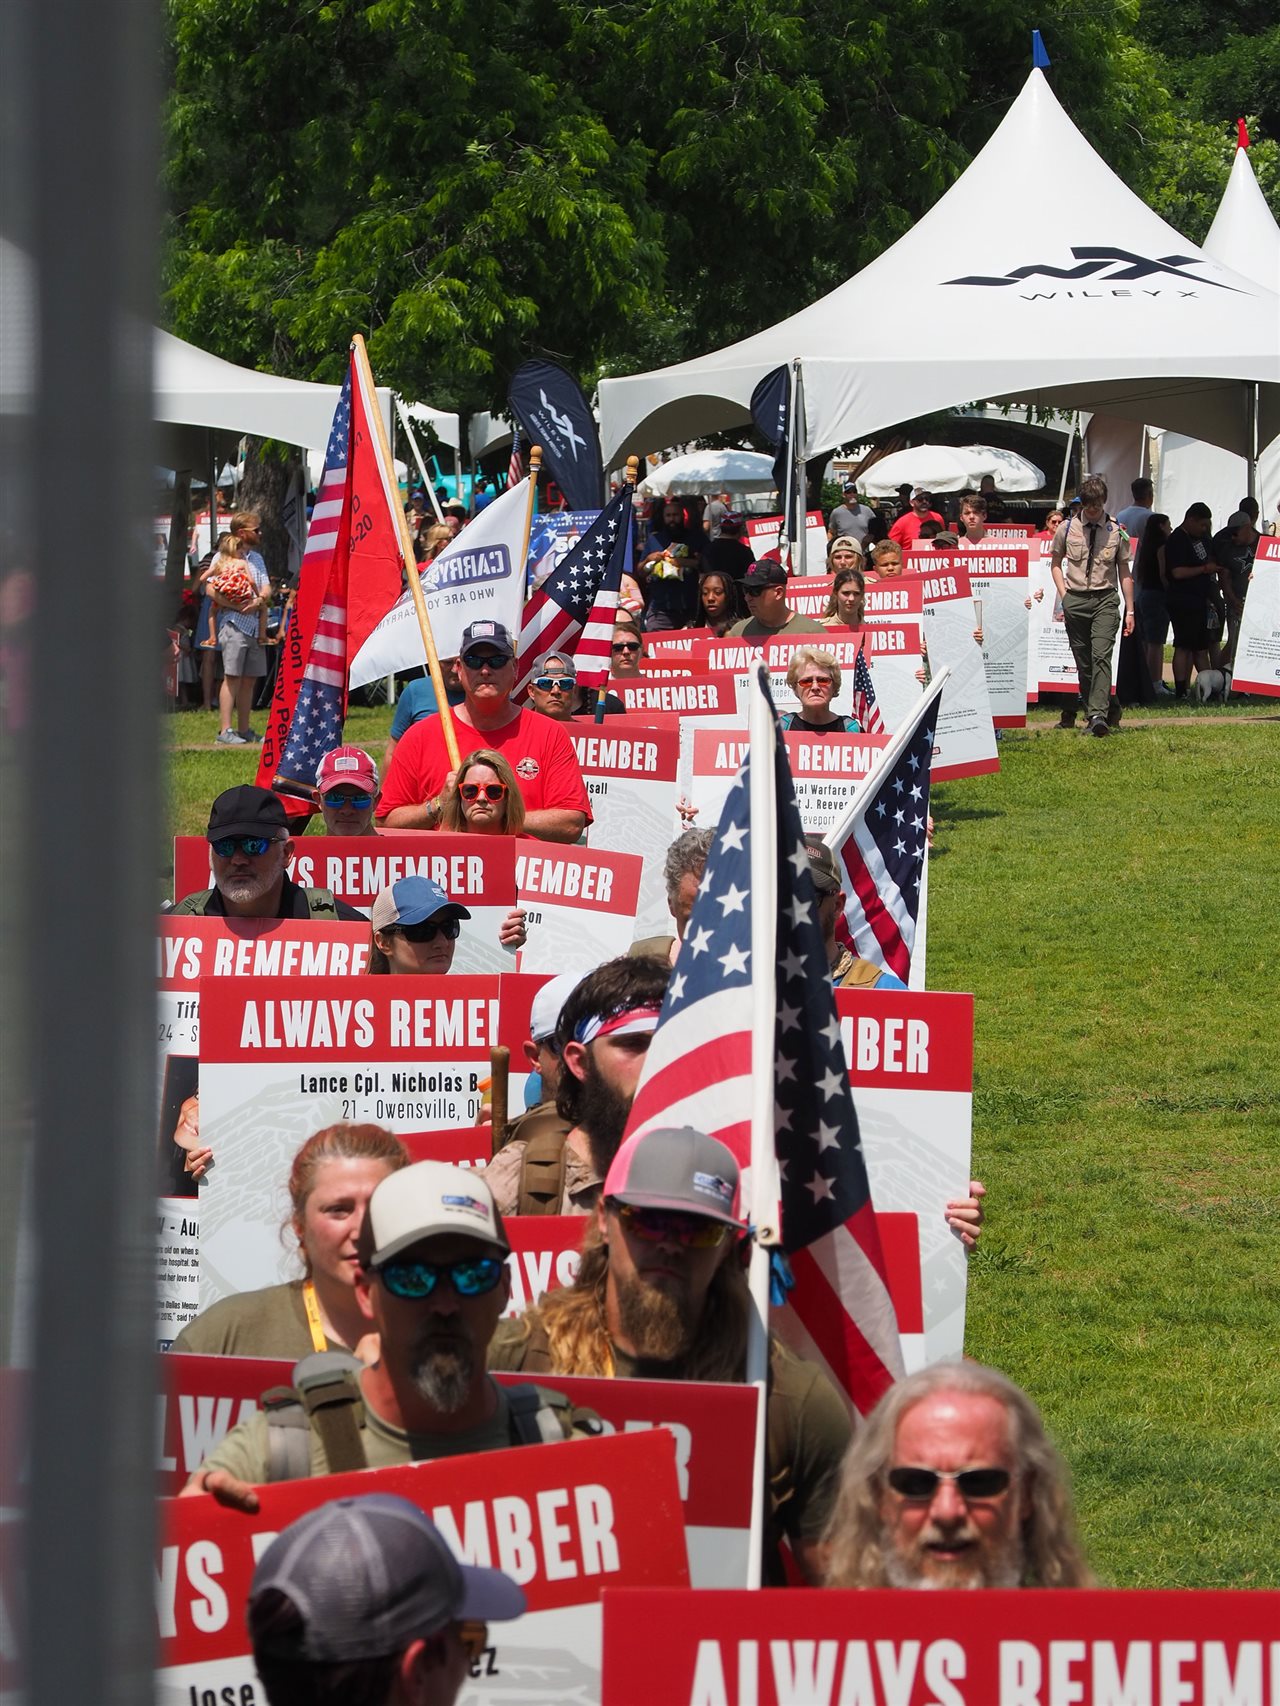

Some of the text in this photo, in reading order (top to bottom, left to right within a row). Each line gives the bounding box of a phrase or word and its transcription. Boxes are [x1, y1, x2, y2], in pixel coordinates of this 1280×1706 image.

[1019, 289, 1199, 300] WILEY X
[810, 784, 847, 796] Warfare
[239, 999, 375, 1048] ALWAYS
[300, 1073, 348, 1094] Lance
[354, 1073, 385, 1097] Cpl.
[392, 1072, 462, 1093] Nicholas
[342, 1101, 357, 1119] 21
[376, 1100, 460, 1121] Owensville,
